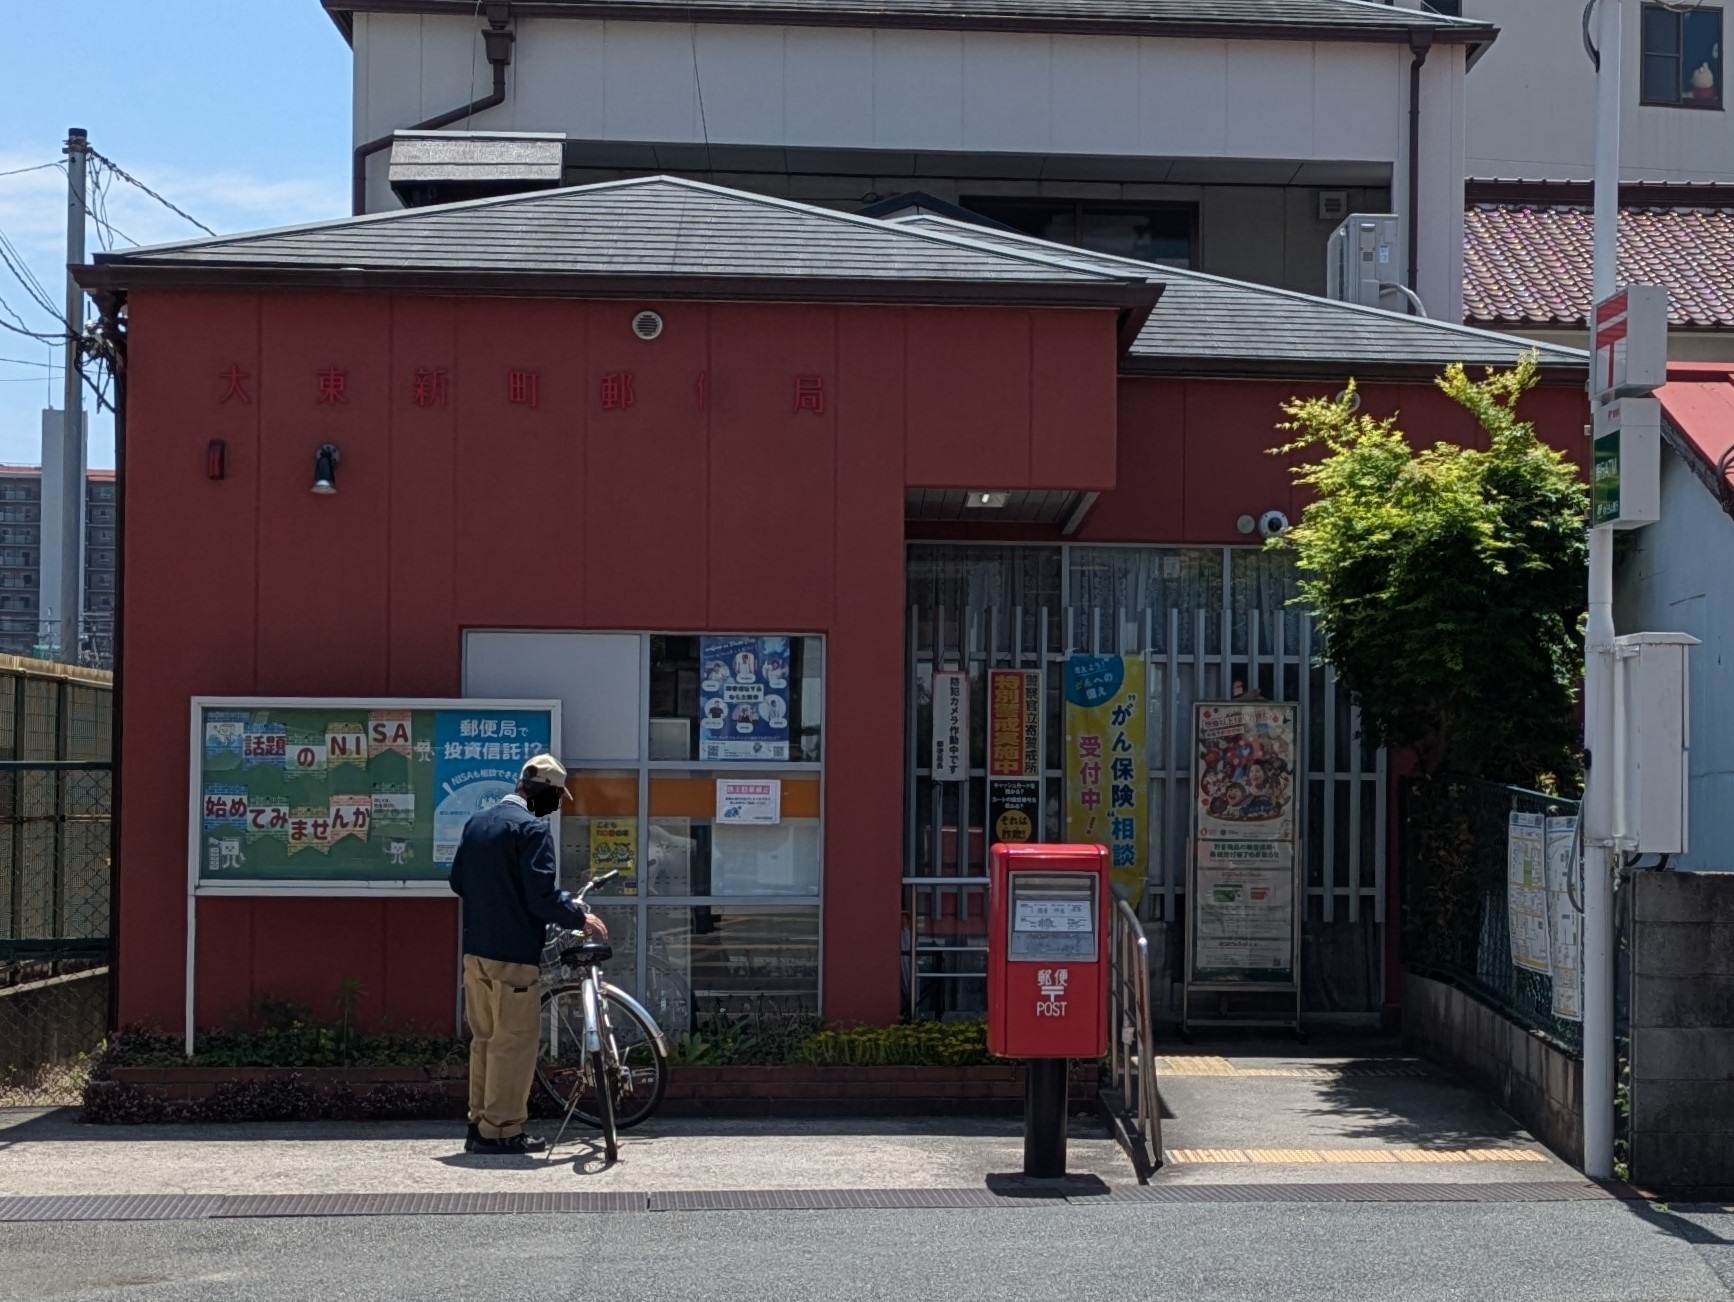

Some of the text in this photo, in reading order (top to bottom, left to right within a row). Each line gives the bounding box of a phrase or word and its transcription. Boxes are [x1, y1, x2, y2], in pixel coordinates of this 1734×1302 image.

[219, 365, 826, 414] 大東新町郵局
[459, 719, 530, 738] 郵便局で
[949, 677, 960, 774] 防犯カメラ作動中です
[994, 675, 1020, 774] 特別警戒実施中
[1024, 674, 1039, 774] 警察官立寄警戒所
[443, 741, 543, 760] 投資信託!?
[1079, 736, 1102, 836] 受付中！
[205, 796, 370, 841] 始めてみませんか
[1000, 815, 1027, 826] それは
[1037, 969, 1068, 986] 郵便
[1036, 1001, 1068, 1017] POST
